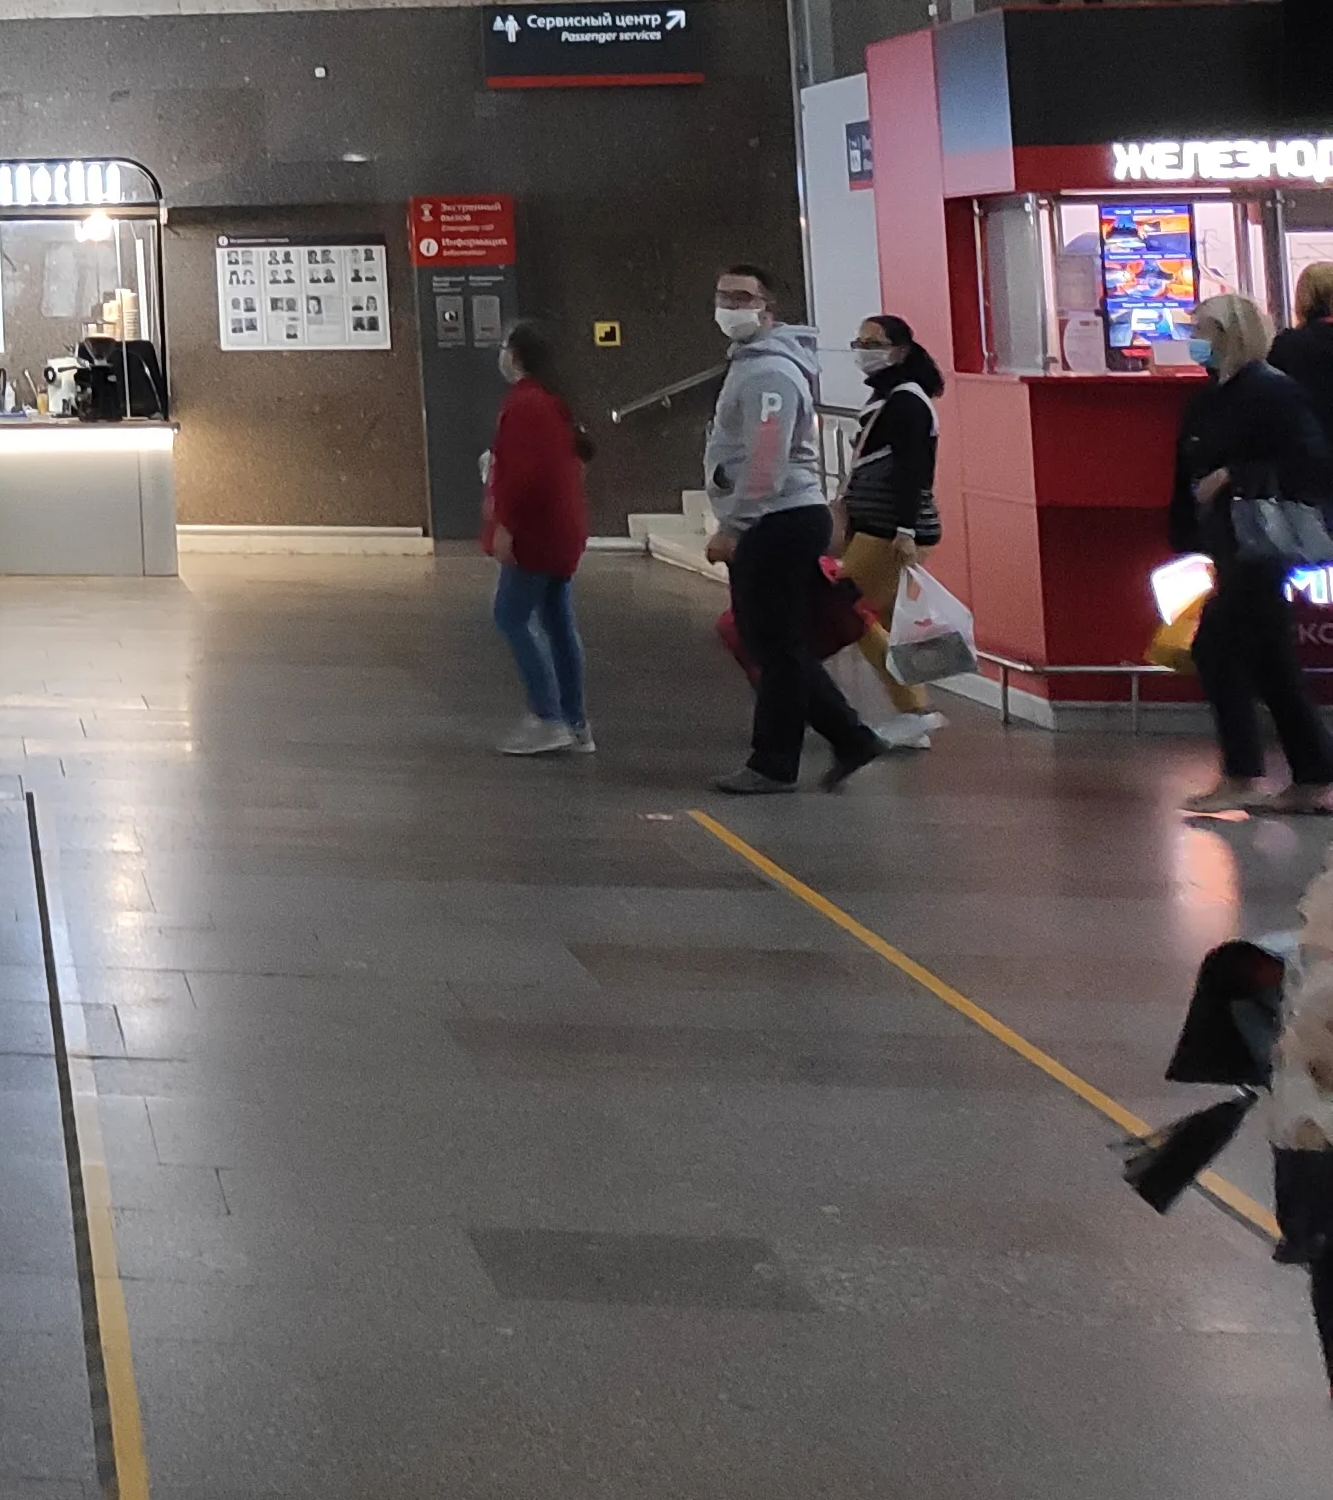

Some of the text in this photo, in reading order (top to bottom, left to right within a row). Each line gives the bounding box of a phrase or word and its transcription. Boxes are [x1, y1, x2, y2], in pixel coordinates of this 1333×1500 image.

[527, 12, 661, 30] Сервисный центр
[561, 30, 661, 44] Passenger services
